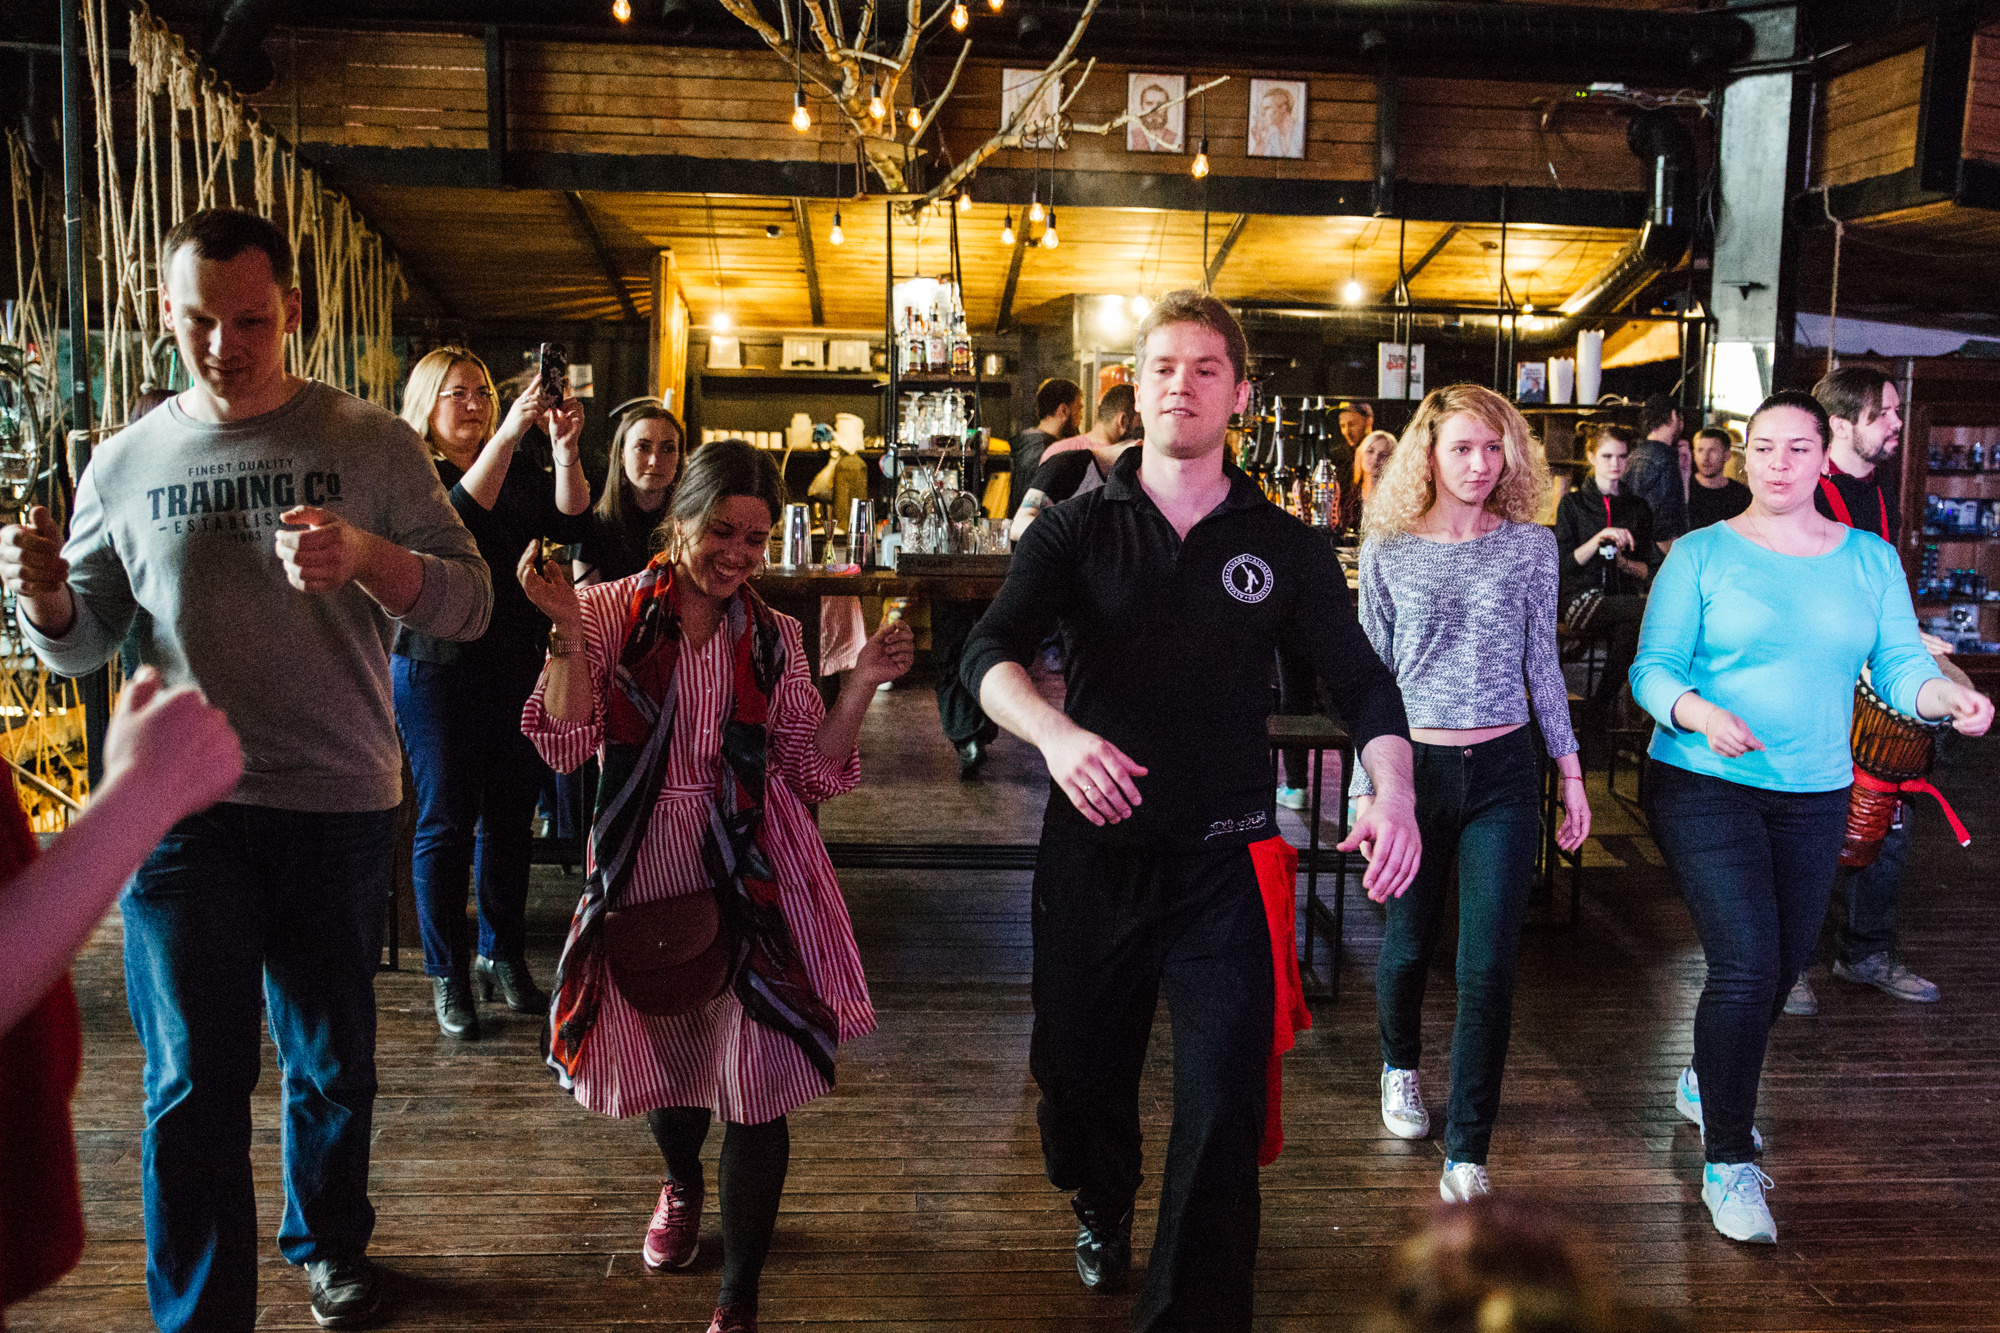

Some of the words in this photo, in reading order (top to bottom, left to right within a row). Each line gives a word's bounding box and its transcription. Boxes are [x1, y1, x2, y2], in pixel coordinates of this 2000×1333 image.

[188, 462, 232, 478] FINEST
[238, 457, 295, 473] QUALITY
[146, 472, 296, 521] TRADING
[174, 511, 282, 535] ESTABLIS
[1225, 554, 1250, 573] ALVARES
[1252, 557, 1272, 581] ALVARES
